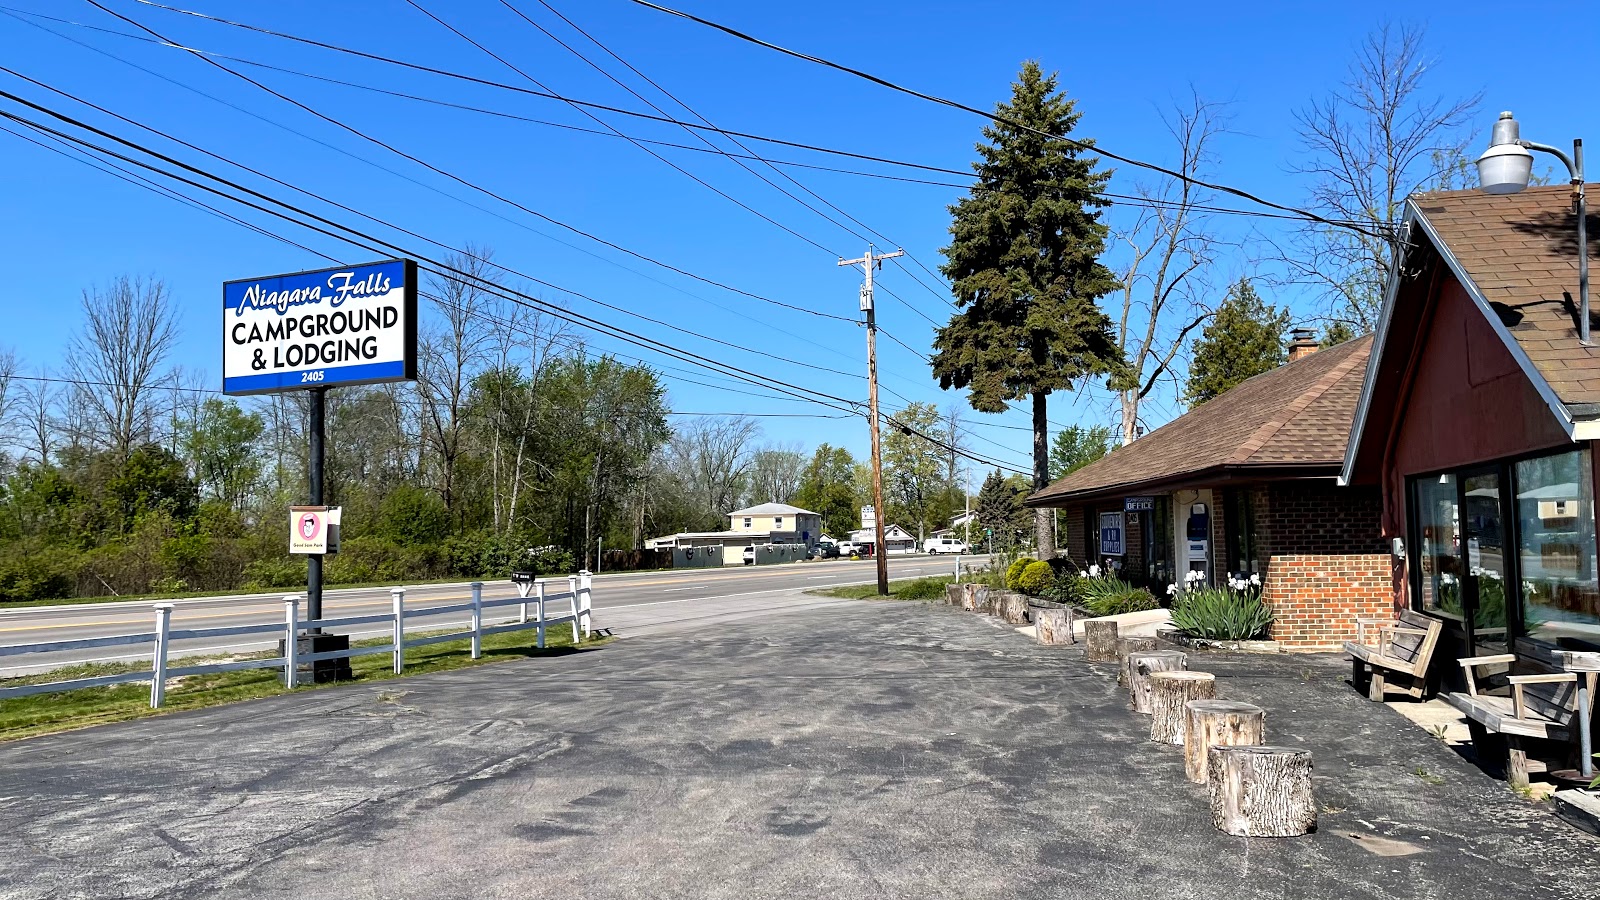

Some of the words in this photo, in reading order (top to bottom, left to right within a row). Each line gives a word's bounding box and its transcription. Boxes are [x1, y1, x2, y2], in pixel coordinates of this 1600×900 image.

[237, 283, 321, 314] Niagara
[327, 272, 391, 305] Falls
[231, 305, 398, 345] CAMPGROUND
[251, 348, 267, 371] &
[273, 336, 378, 369] LODGING
[301, 371, 324, 383] 2405
[1127, 502, 1152, 510] OFFICE
